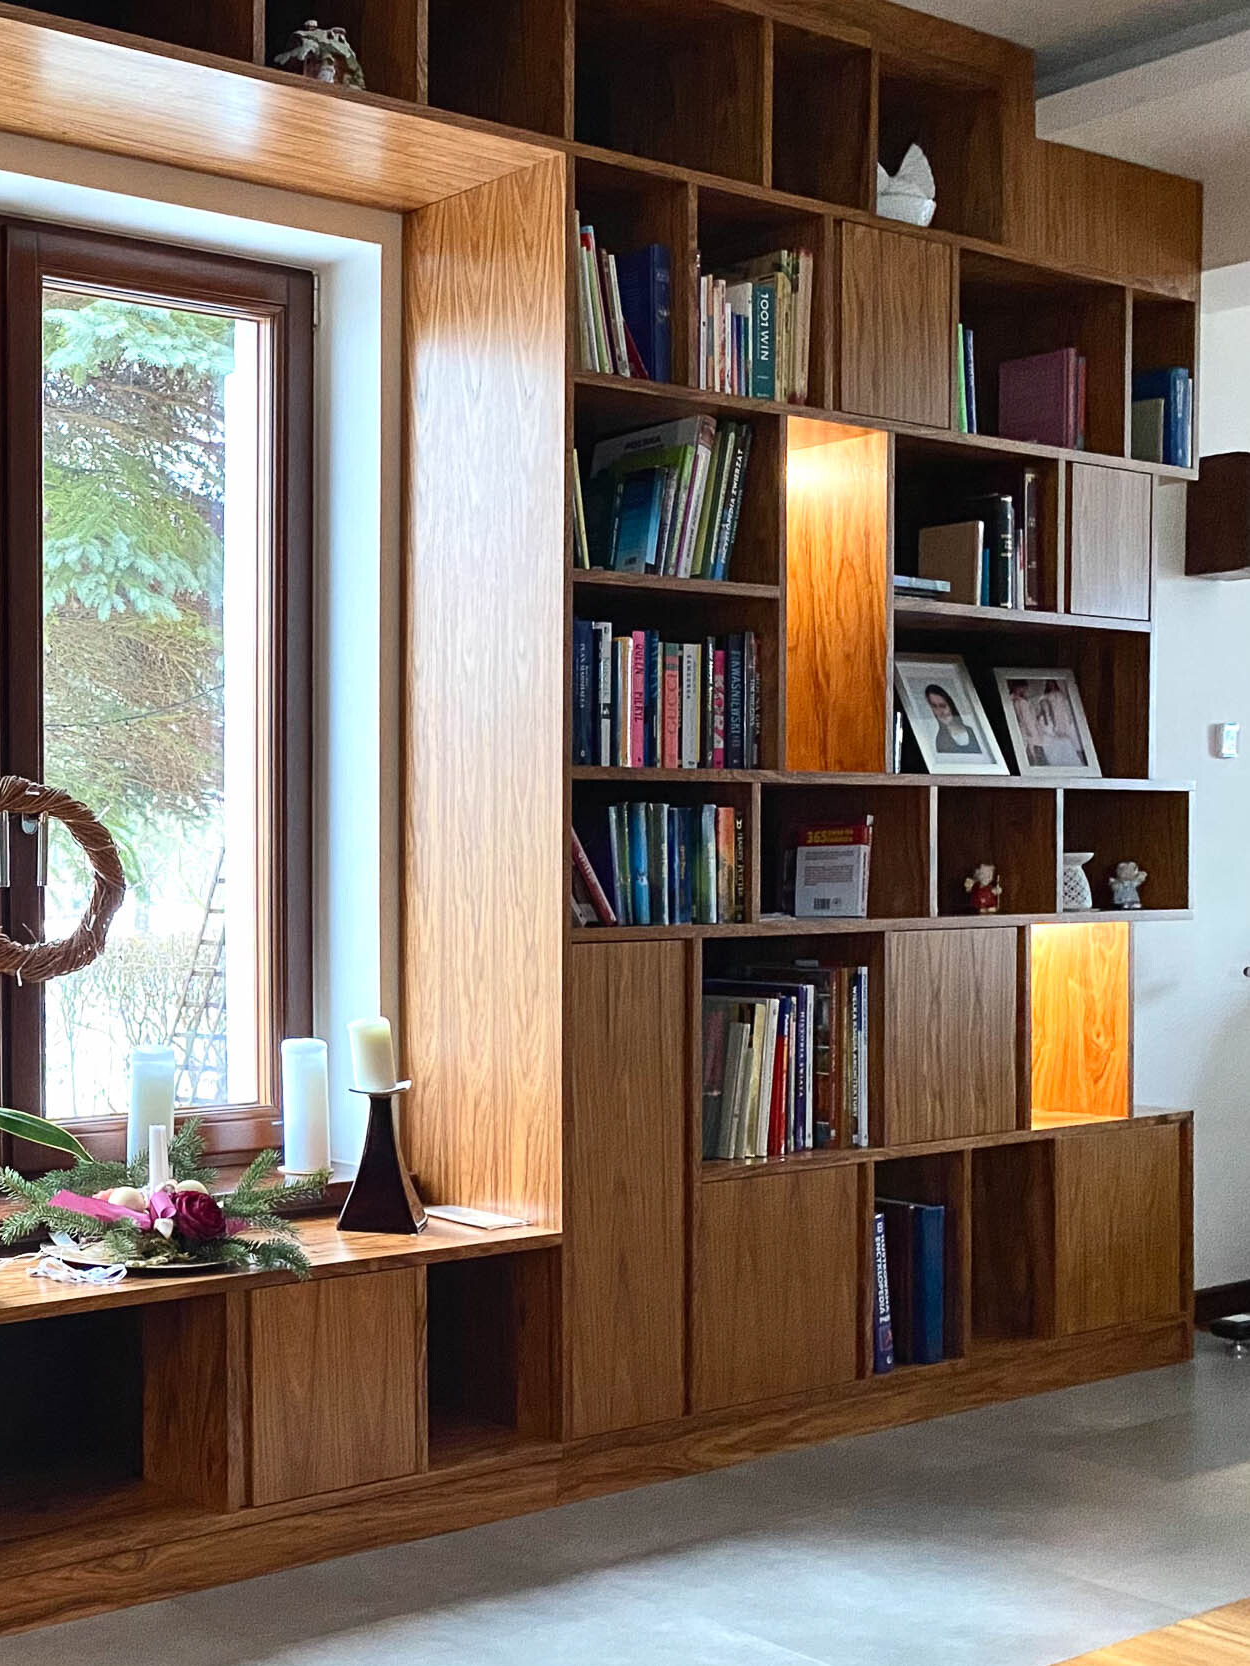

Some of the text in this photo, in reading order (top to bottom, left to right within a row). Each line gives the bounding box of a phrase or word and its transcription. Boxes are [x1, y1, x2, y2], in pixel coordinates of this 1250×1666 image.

[760, 292, 768, 360] 1001 WIN
[635, 643, 643, 674] QUEEN
[667, 673, 676, 734] GUCCI
[714, 674, 724, 748] KORA
[875, 1235, 885, 1314] ENCYKLOPEDIA
